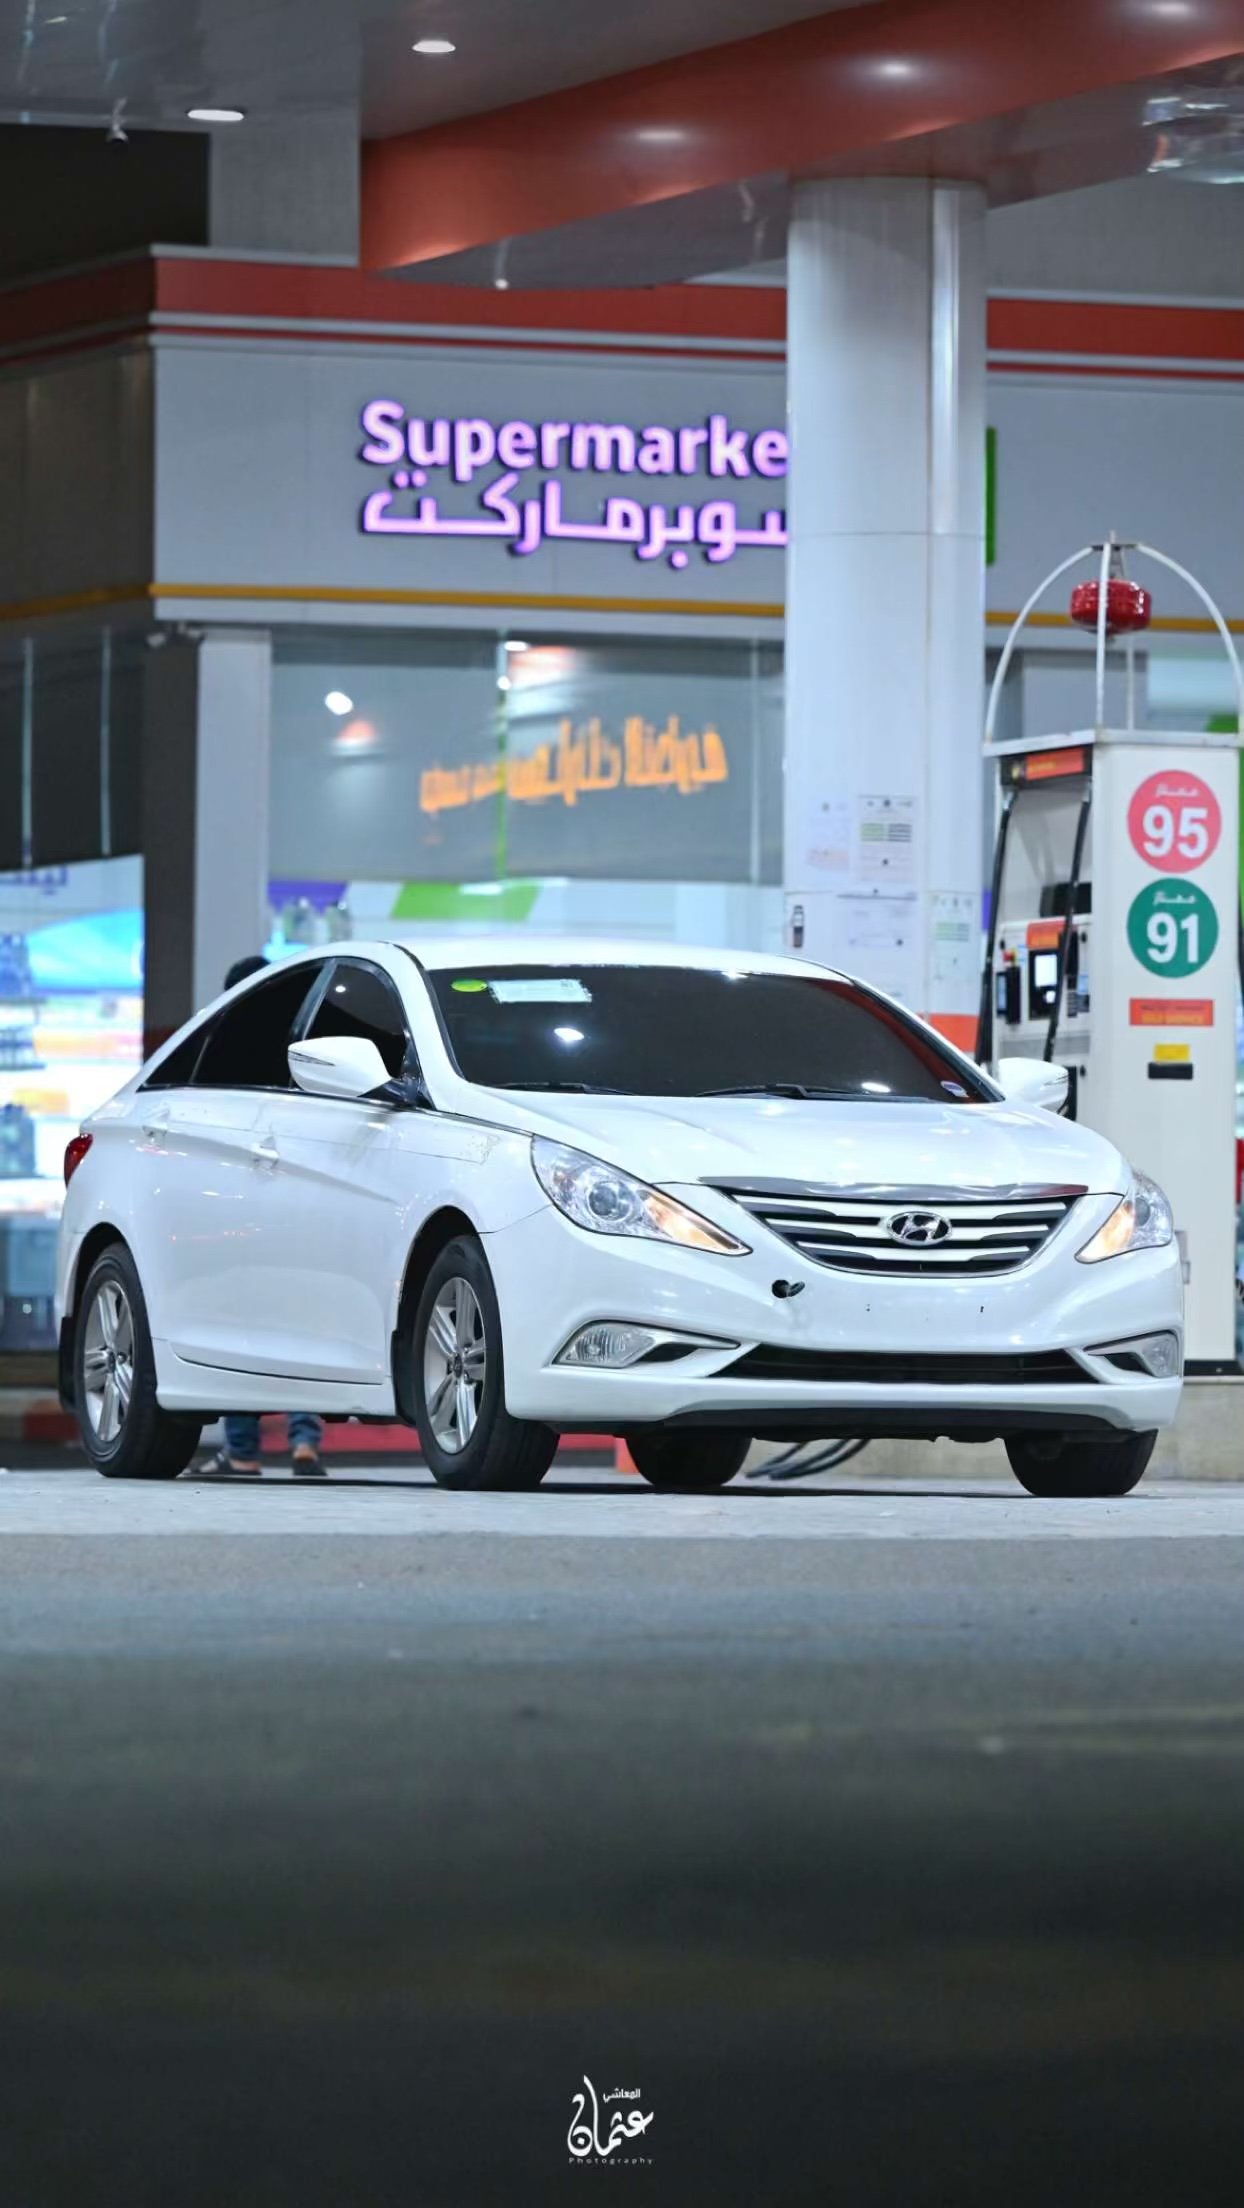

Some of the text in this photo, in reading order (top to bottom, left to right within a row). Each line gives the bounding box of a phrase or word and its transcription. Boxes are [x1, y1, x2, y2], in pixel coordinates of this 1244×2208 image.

[362, 400, 788, 482] Supermarke
[1142, 804, 1209, 860] 95
[1146, 911, 1200, 965] 91
